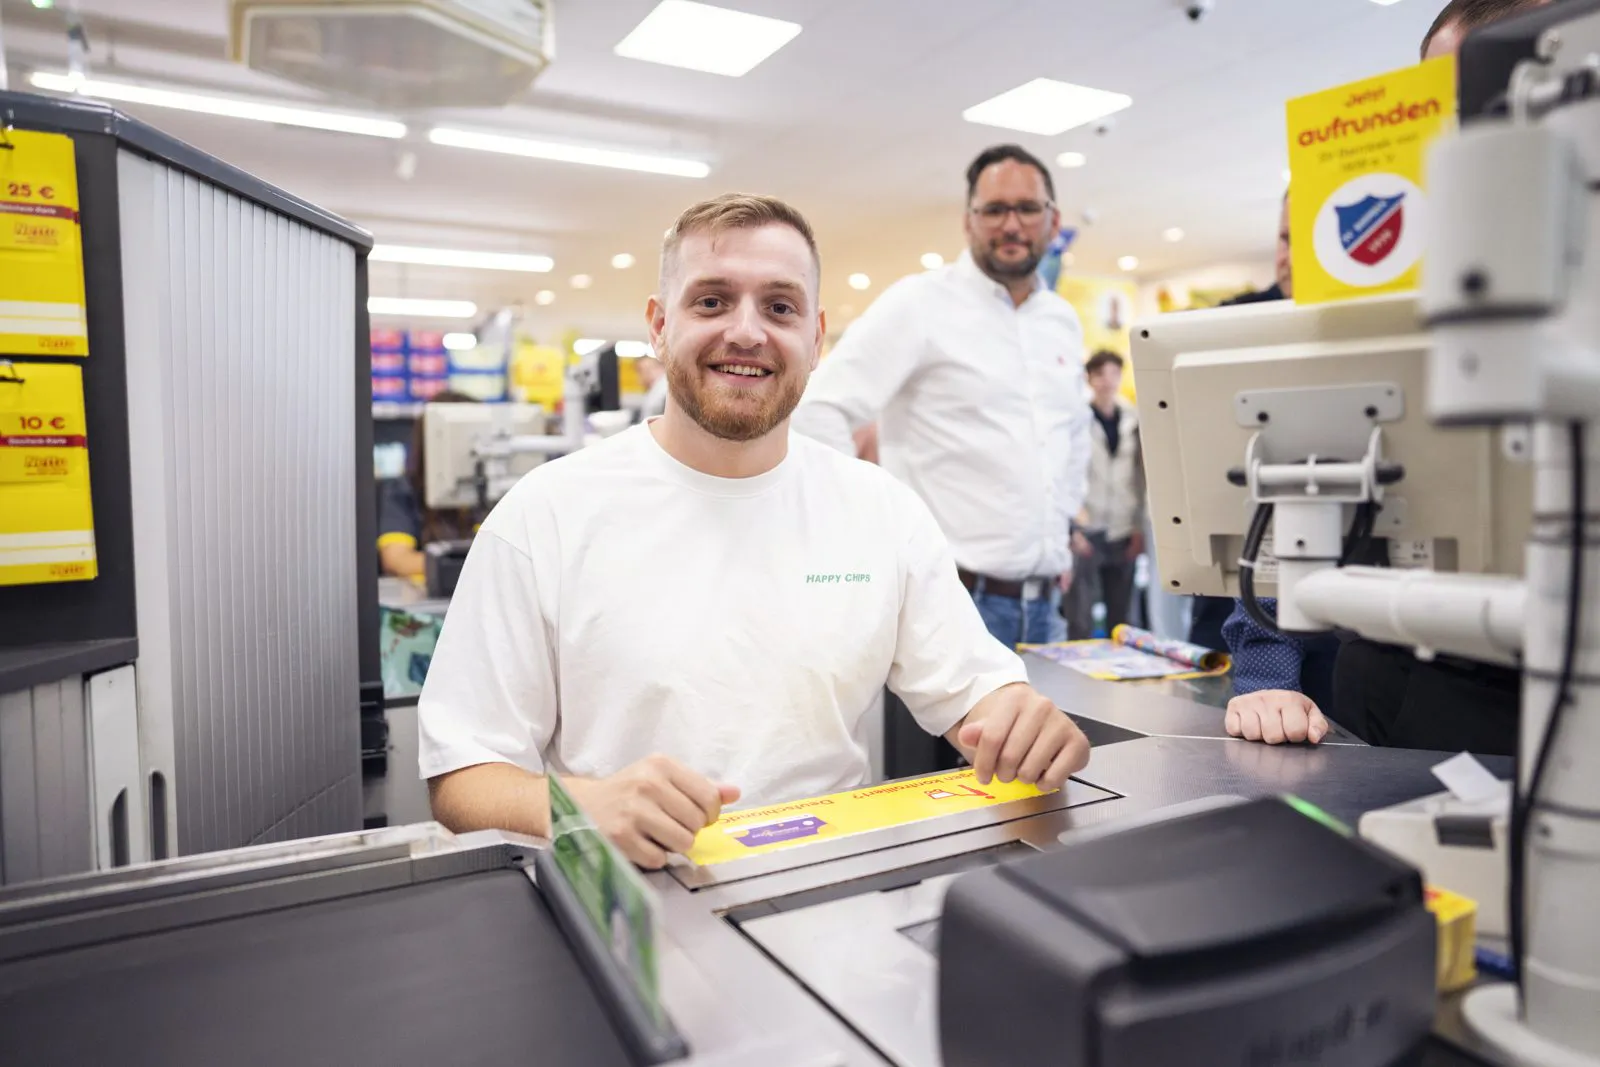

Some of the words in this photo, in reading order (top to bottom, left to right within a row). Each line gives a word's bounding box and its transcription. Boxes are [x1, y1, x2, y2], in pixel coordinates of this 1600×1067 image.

[1297, 97, 1441, 148] aufrunden
[8, 183, 32, 197] 25
[39, 185, 55, 199] €
[19, 416, 43, 431] 10
[48, 416, 66, 431] €
[806, 574, 842, 584] HAPPY
[844, 573, 871, 583] CHIPS
[852, 778, 945, 799] kontrolliert?
[720, 798, 835, 824] DeutschlandC
